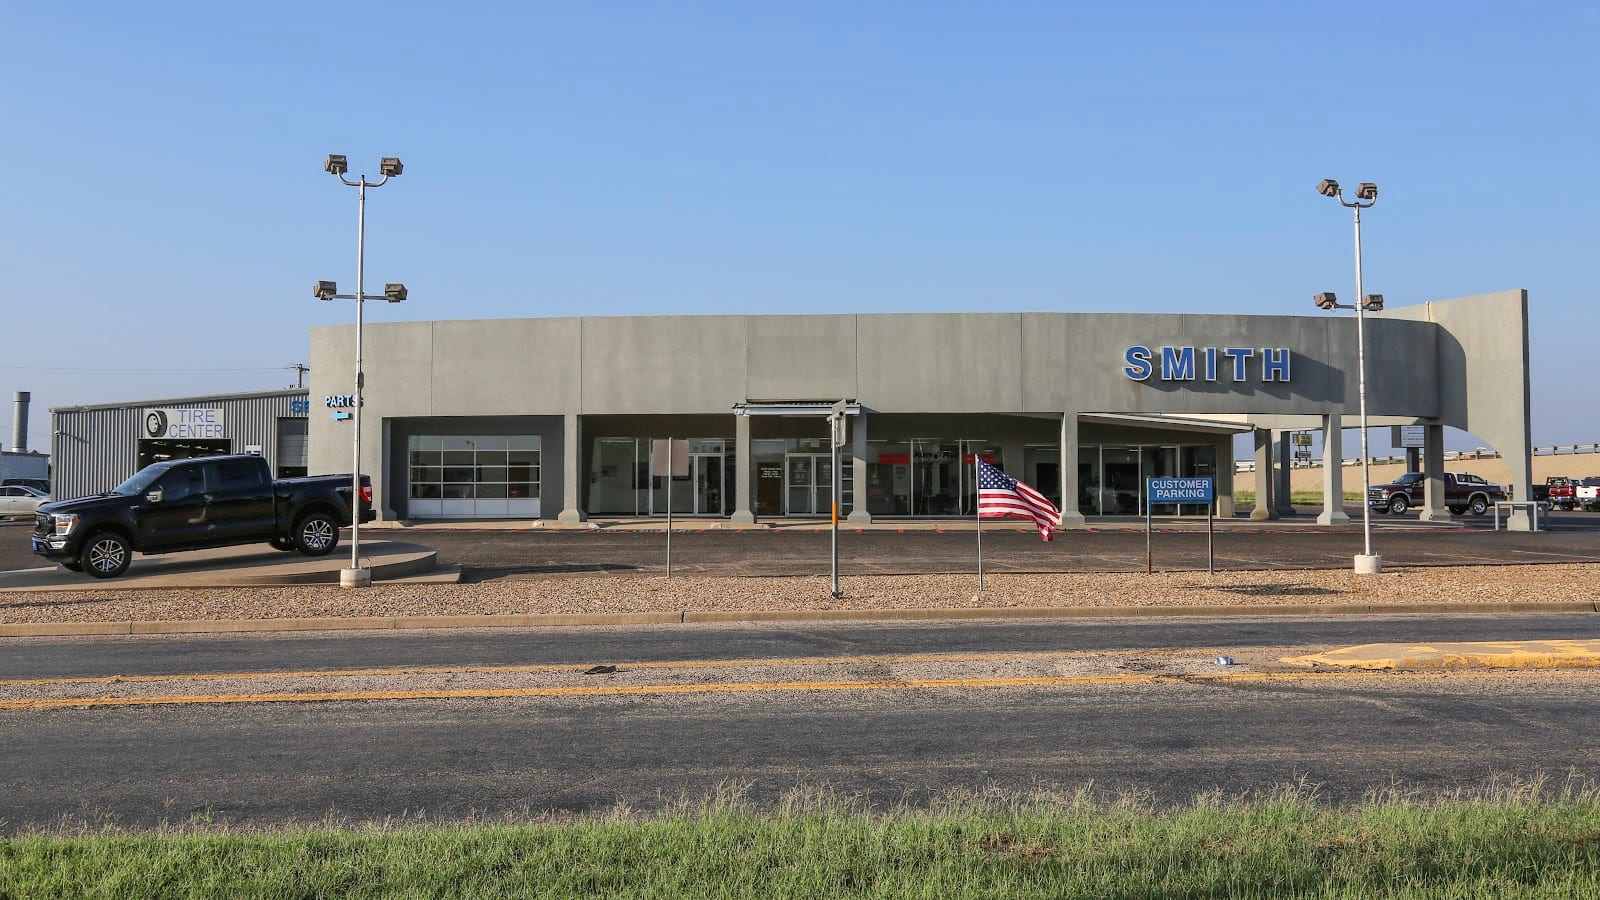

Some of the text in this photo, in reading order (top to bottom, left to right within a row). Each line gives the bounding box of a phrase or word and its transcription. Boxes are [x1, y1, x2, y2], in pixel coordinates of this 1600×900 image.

[1122, 345, 1291, 382] SMITH
[177, 409, 215, 423] TIRE
[168, 424, 223, 438] CENTER
[1151, 480, 1209, 489] CUSTOMER
[1156, 489, 1205, 498] PARKING
